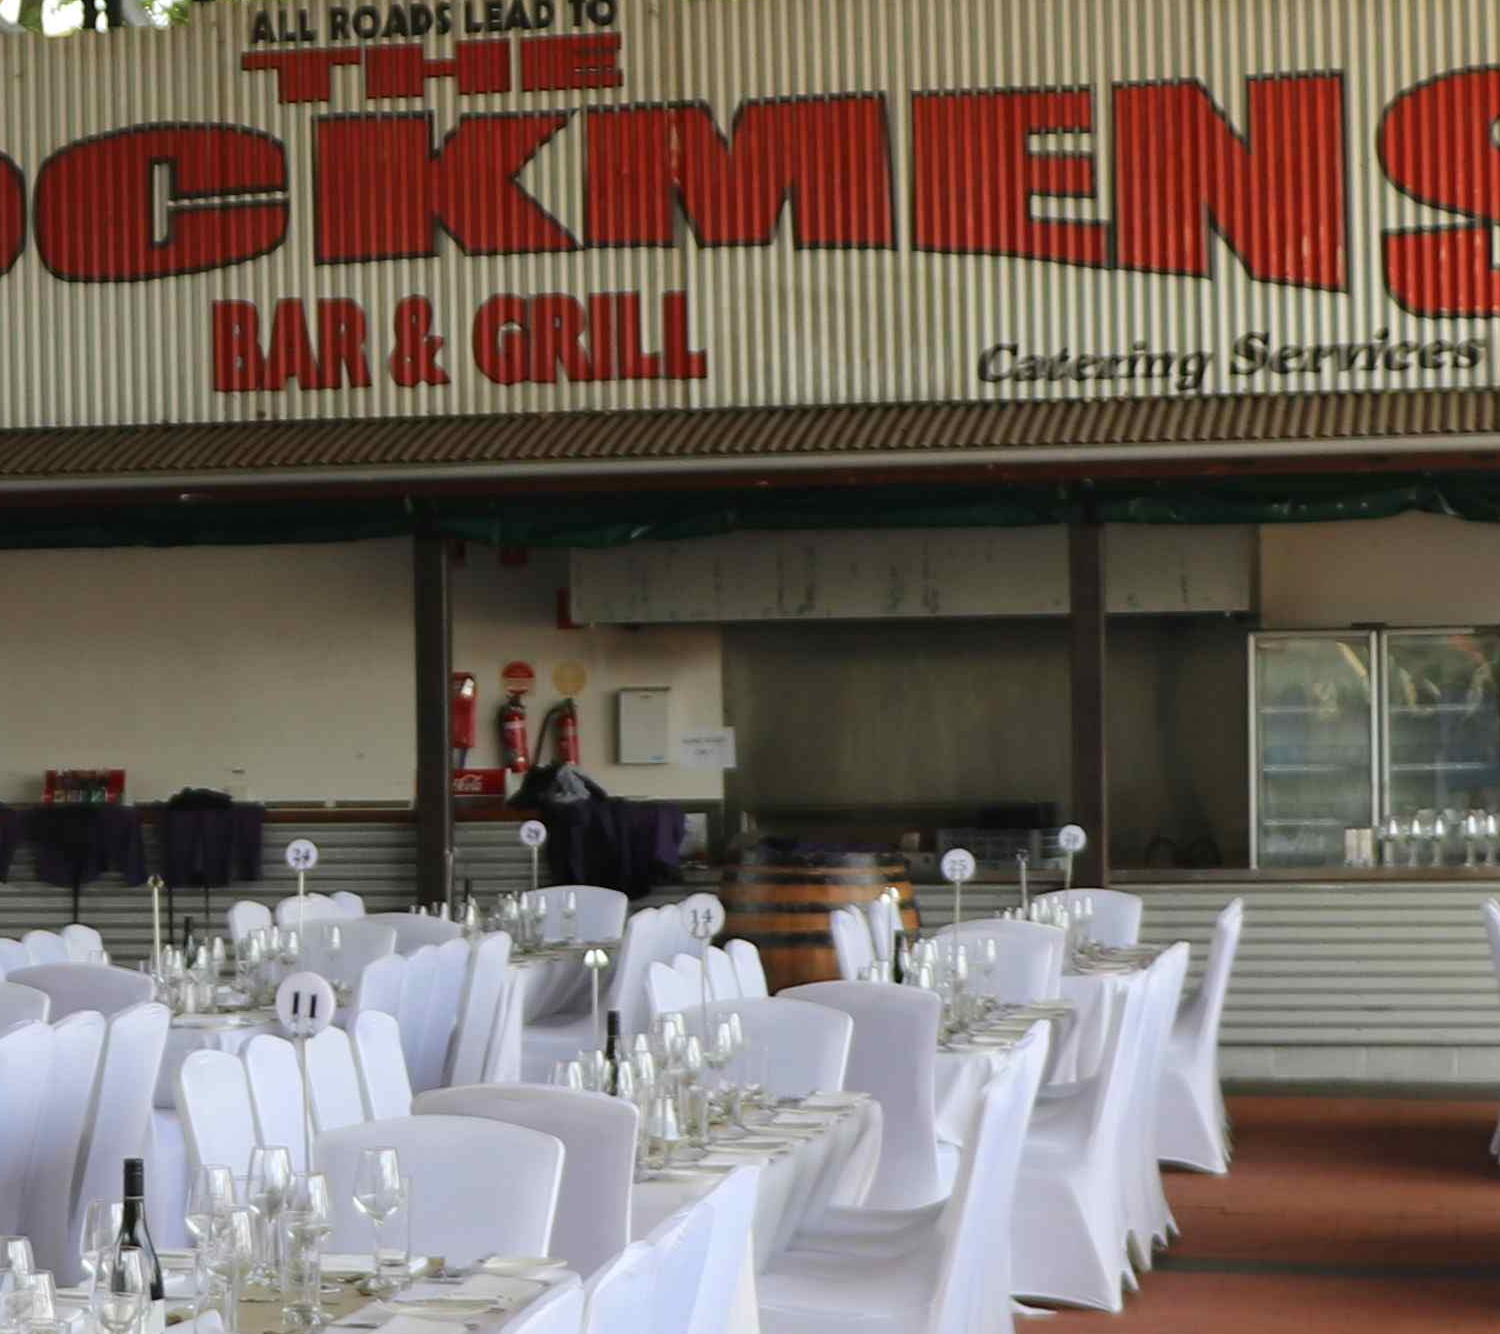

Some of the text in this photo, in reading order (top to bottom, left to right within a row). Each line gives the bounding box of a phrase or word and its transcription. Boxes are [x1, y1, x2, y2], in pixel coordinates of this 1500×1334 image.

[251, 10, 316, 43] ALL
[329, 2, 453, 40] ROADS
[241, 32, 623, 103] THE
[212, 289, 708, 393] BAR & GRILL
[977, 326, 1486, 391] Catering Services
[690, 908, 711, 925] 14
[290, 990, 317, 1019] 11
